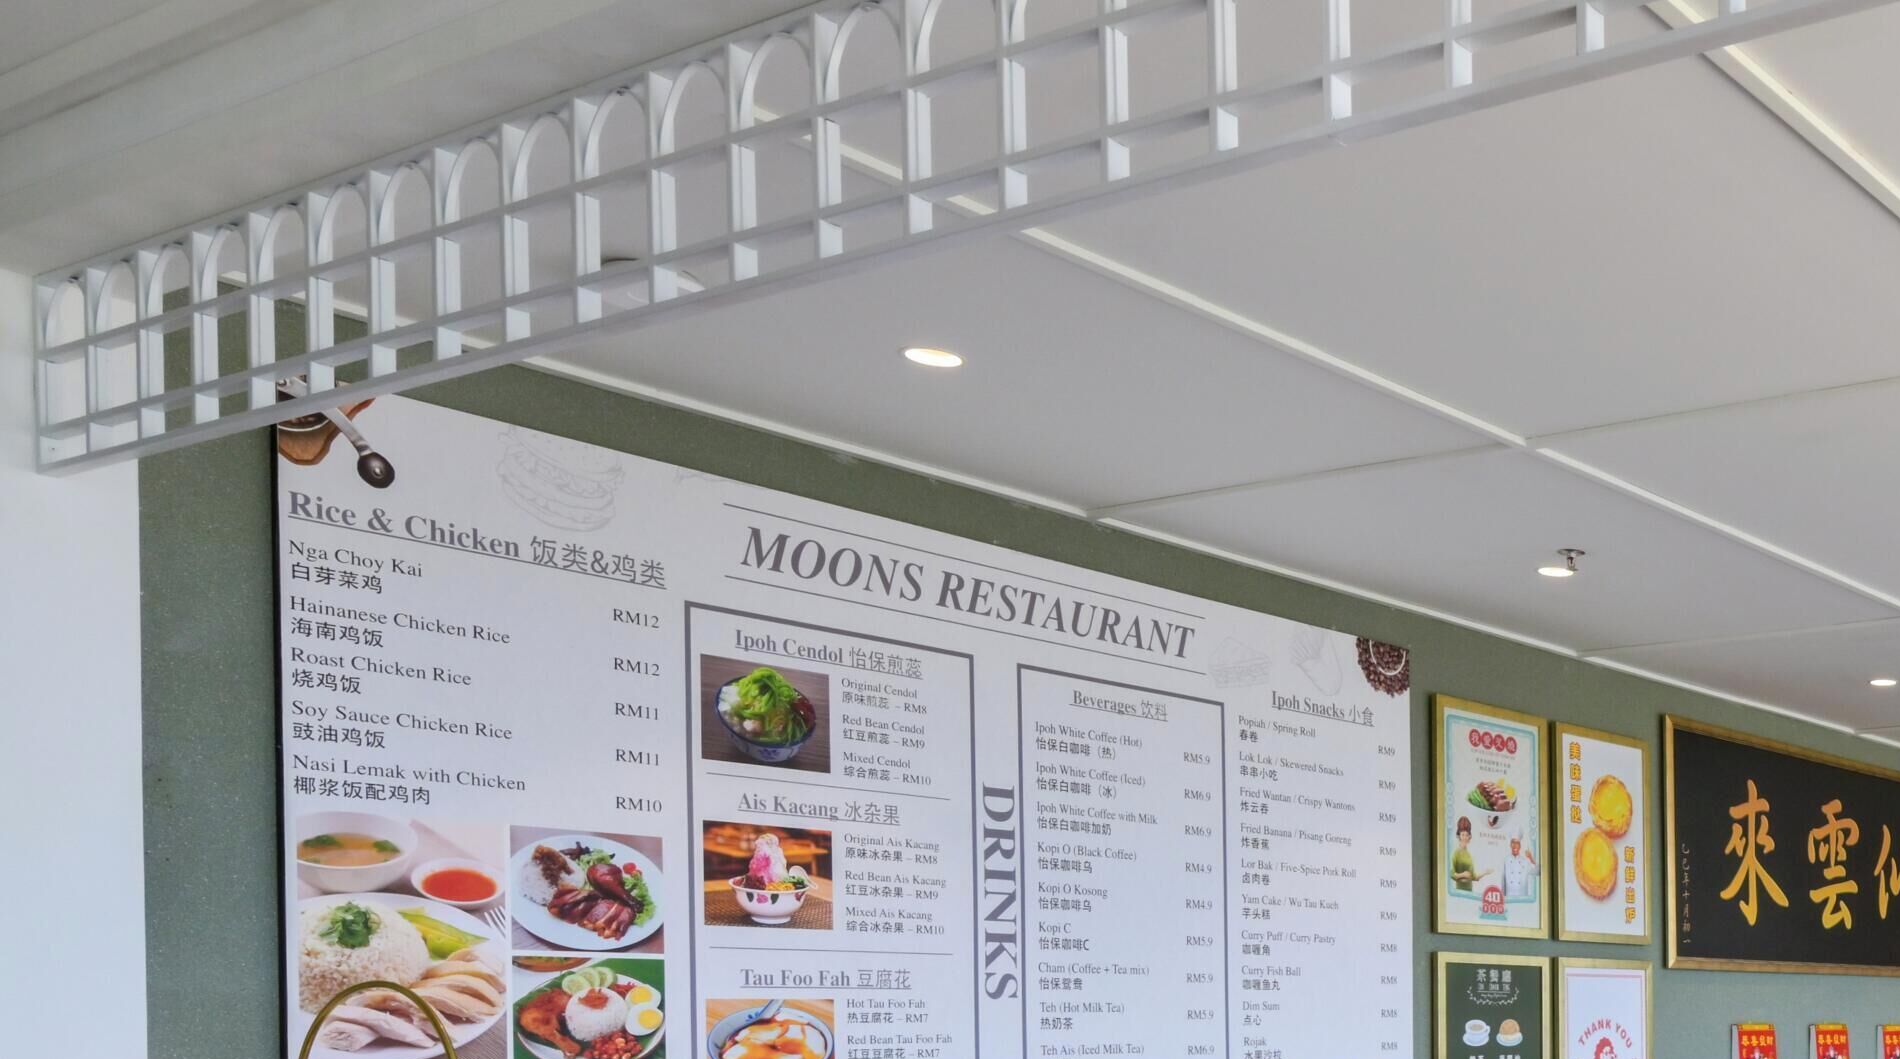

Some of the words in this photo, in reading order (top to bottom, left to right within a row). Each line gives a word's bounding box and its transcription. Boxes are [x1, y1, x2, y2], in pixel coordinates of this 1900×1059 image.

[287, 490, 357, 526] Rice
[404, 514, 520, 558] Chicken
[288, 539, 329, 563] Nga
[334, 548, 384, 574] Choy
[391, 558, 422, 577] Kai
[291, 561, 383, 595] 白芽菜鸡
[739, 525, 924, 602] MOONS
[934, 569, 1196, 659] RESTAURANT
[289, 595, 388, 625] Hainanese
[393, 612, 466, 637] Chicken
[472, 624, 510, 644] Rice
[612, 607, 660, 629] RM12
[290, 616, 384, 648] 海南鸡饭
[735, 629, 777, 653] Ipoh
[781, 638, 843, 664] Cendol
[290, 646, 345, 669] Roast
[350, 655, 426, 680] Chicken
[432, 667, 471, 686] Rice
[613, 657, 660, 677] RM12
[291, 667, 361, 695] 烧鸡饭
[840, 676, 882, 693] Original
[883, 684, 918, 700] Cendol
[615, 702, 658, 721] RM11
[1073, 689, 1137, 714] Beverages
[1140, 699, 1168, 721] 饮料
[1271, 689, 1300, 711] Ipoh
[1303, 696, 1345, 720] Snacks
[1348, 704, 1375, 726] 小食
[291, 699, 328, 722] Soy
[335, 705, 390, 726] Sauce
[395, 712, 469, 735] Chicken
[474, 721, 512, 740] Rice
[841, 713, 862, 727] Red
[864, 717, 890, 730] Bean
[890, 720, 925, 735] Cendol
[292, 722, 386, 749] 豉油鸡饭
[1035, 721, 1056, 736] Ipoh
[1058, 724, 1086, 740] White
[1087, 728, 1118, 744] Coffee
[1119, 734, 1143, 748] (Hot)
[615, 748, 659, 767] RM11
[842, 750, 875, 765] Mixed
[876, 755, 911, 769] Cendol
[1182, 751, 1211, 765] RM5.9
[292, 754, 336, 773] Nasi
[343, 759, 406, 780] Lemak
[412, 767, 451, 784] with
[456, 770, 525, 791] Chicken
[1035, 760, 1057, 776] Ipoh
[1058, 764, 1087, 779] White
[1087, 768, 1118, 783] Coffee
[1119, 773, 1146, 787] (Iced)
[293, 775, 430, 805] 椰浆饭配鸡肉
[1183, 787, 1211, 801] RM6.9
[615, 796, 662, 812] RM10
[737, 792, 767, 812] Ais
[772, 795, 839, 819] Kacang
[843, 800, 900, 824] 冰杂果
[1036, 800, 1057, 817] Ipoh
[1058, 803, 1085, 817] White
[1086, 807, 1116, 821] Coffee
[1117, 810, 1136, 823] with
[1137, 812, 1158, 825] Milk
[1036, 815, 1112, 837] 怡保白咖啡加奶
[1183, 824, 1212, 838] RM6.9
[843, 832, 884, 847] Original
[885, 836, 903, 847] Ais
[904, 838, 940, 853] Kacang
[1036, 840, 1060, 856] Kopi
[1061, 843, 1071, 855] O
[1073, 844, 1102, 858] (Black
[1104, 847, 1137, 861] Coffee)
[1037, 856, 1093, 874] 怡保咖啡乌
[1184, 861, 1212, 874] RM4.9
[981, 781, 1019, 1000] DRINKS
[845, 906, 877, 918] Mixed
[878, 908, 895, 919] Ais
[897, 908, 933, 923] Kacang
[1038, 920, 1061, 938] Kopi
[1062, 921, 1071, 934] C
[1037, 936, 1090, 951] 怡保咖啡C
[1185, 935, 1214, 947] RM5.9
[740, 968, 776, 987] Tau
[780, 969, 812, 987] Foo
[817, 969, 851, 987] Fah
[856, 968, 912, 989] 豆腐花
[1240, 964, 1265, 977] Curry
[1265, 965, 1284, 977] Fish
[1284, 966, 1301, 977] Ball
[845, 997, 865, 1009] Hot
[866, 998, 885, 1009] Tau
[886, 998, 906, 1009] Foo
[907, 998, 925, 1009] Fah
[1039, 1000, 1057, 1013] Teh
[1058, 1001, 1080, 1015] (Hot
[1082, 1001, 1104, 1013] Milk
[1104, 1001, 1125, 1013] Tea)
[1186, 1008, 1215, 1020] RM5.9
[1241, 999, 1260, 1011] Dim
[1261, 1000, 1280, 1011] Sum
[1039, 1016, 1073, 1031] 热奶茶
[1578, 1018, 1612, 1046] THANK
[1614, 1023, 1633, 1049] YOU
[846, 1034, 867, 1048] Red
[868, 1033, 894, 1045] Bean
[895, 1034, 913, 1045] Tau
[914, 1033, 934, 1044] Foo
[935, 1033, 953, 1044] Fah
